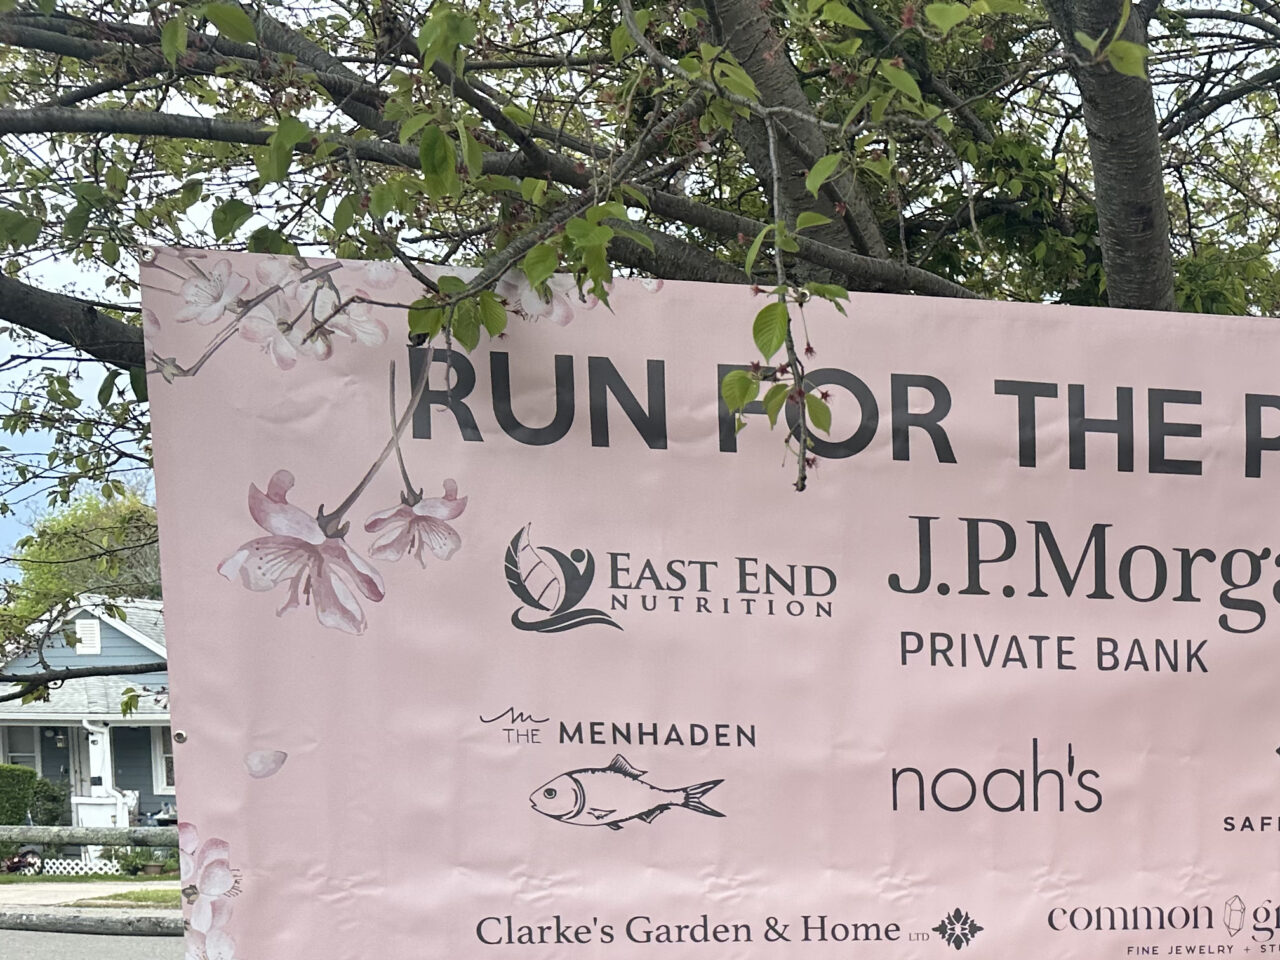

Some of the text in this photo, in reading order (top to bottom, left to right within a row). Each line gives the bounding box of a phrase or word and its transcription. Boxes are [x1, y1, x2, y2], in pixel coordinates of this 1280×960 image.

[408, 346, 668, 449] RUN
[717, 363, 958, 464] FOR
[995, 379, 1202, 475] THE
[611, 595, 833, 617] NUTRITION
[900, 631, 1208, 673] PRIVATE BANK
[502, 721, 756, 747] THE MENHADEN
[892, 738, 1103, 813] noah's
[475, 915, 930, 946] Clarke's Garden & Home LTD
[1048, 901, 1214, 932] common
[1127, 945, 1160, 955] FINE
[1167, 944, 1234, 955] JEWELRY
